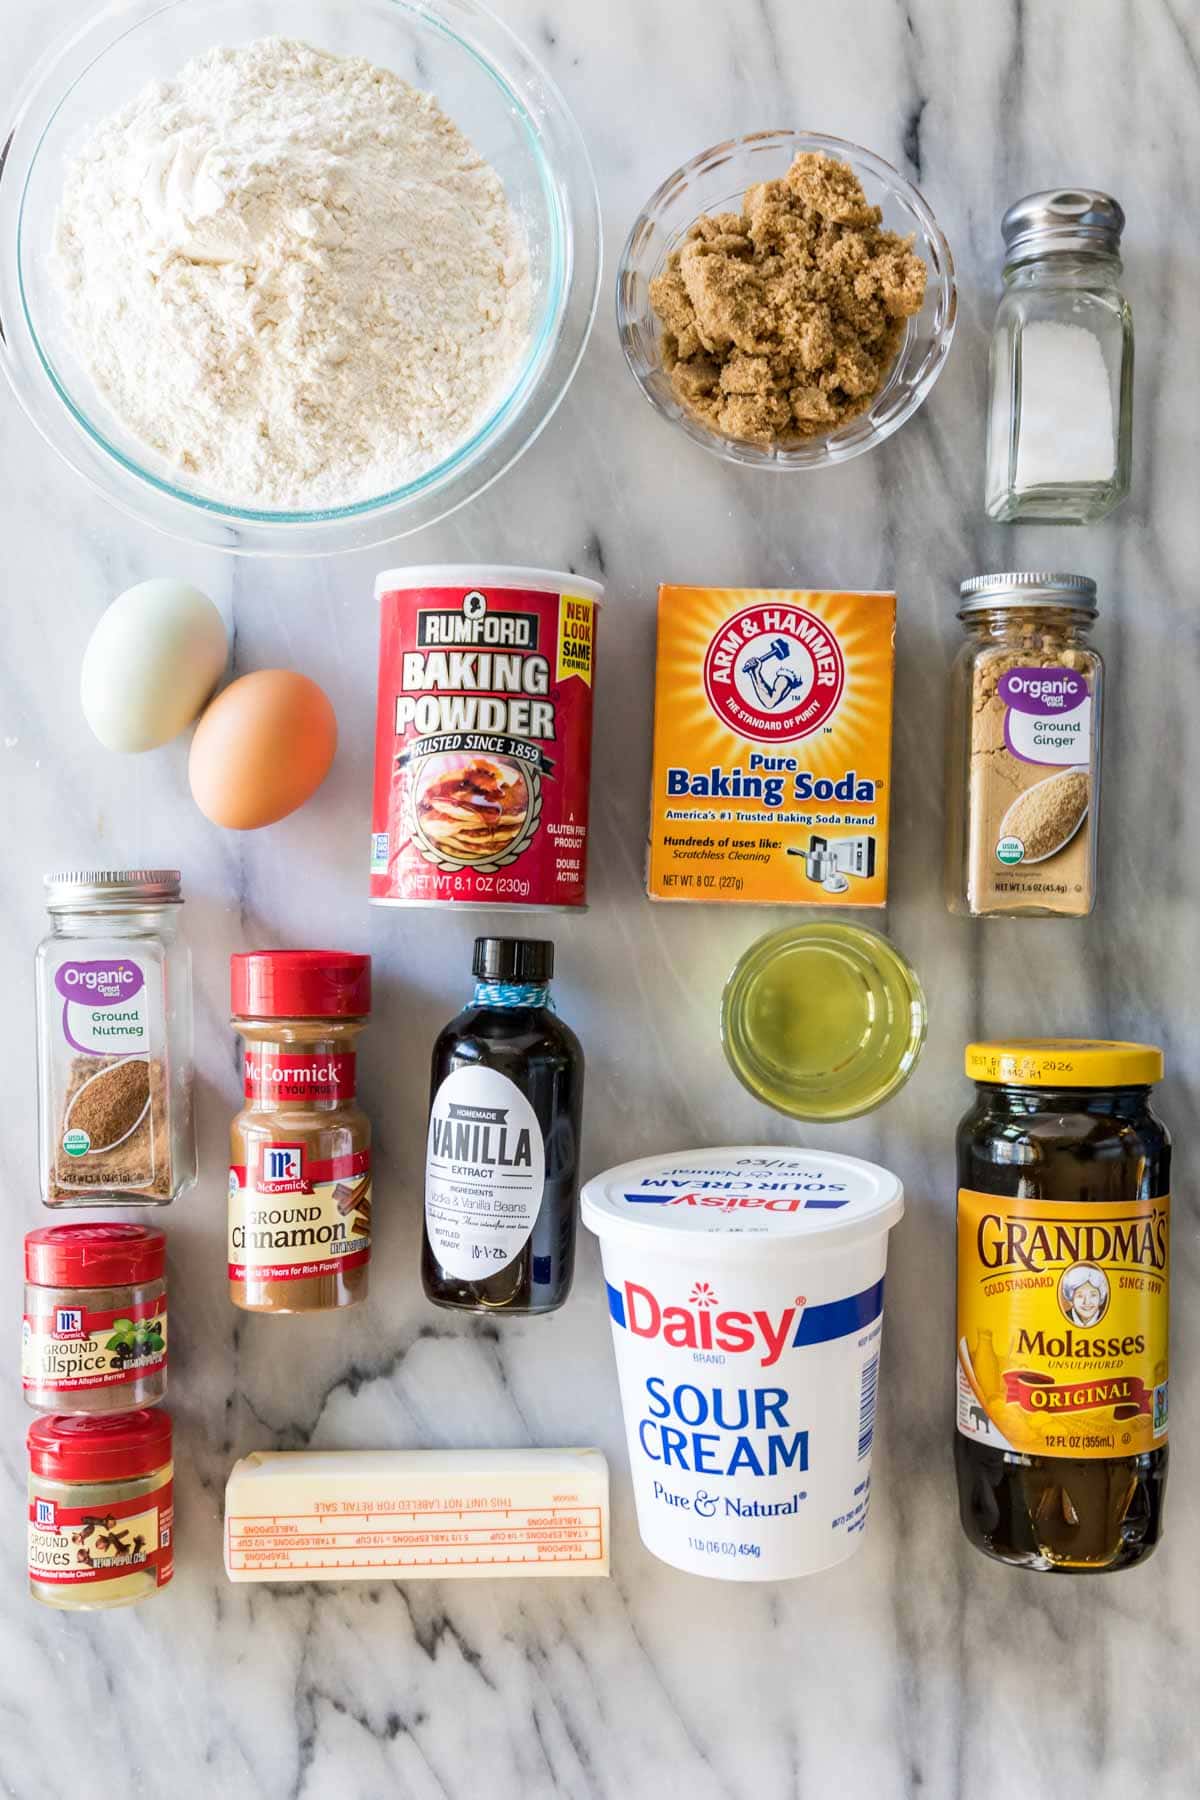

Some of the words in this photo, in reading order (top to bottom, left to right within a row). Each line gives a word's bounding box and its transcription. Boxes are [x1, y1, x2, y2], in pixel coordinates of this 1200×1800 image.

[567, 602, 590, 623] NEW
[425, 615, 529, 646] RUMFORD
[564, 621, 590, 643] LOOK
[563, 640, 590, 660] SAME
[713, 630, 745, 685] ARM
[741, 618, 762, 638] &
[762, 611, 836, 687] HAMMER
[403, 652, 549, 696] BAKING
[1008, 676, 1078, 698] Organic
[396, 695, 555, 739] POWDER
[726, 697, 738, 714] THE
[738, 710, 782, 730] STANDARD
[784, 718, 795, 729] OF
[794, 699, 821, 725] PURITY
[1033, 721, 1080, 732] Ground
[1033, 735, 1076, 748] Ginger
[411, 735, 460, 758] RUSTED
[464, 735, 504, 752] SINCE
[510, 742, 539, 762] 1859
[750, 754, 797, 771] Pure
[667, 768, 784, 806] Baking
[794, 772, 875, 802] Soda
[666, 810, 716, 820] America's
[720, 812, 732, 820] #1
[736, 812, 773, 822] Trusted
[776, 814, 812, 825] Baking
[816, 814, 841, 824] Soda
[844, 815, 876, 826] Brand
[547, 824, 574, 835] GLUTEN
[554, 838, 582, 848] PRODUCT
[663, 836, 714, 847] Hundreds
[718, 836, 730, 848] of
[732, 839, 756, 848] uses
[759, 838, 782, 848] like:
[672, 848, 724, 860] Scratchless
[728, 851, 771, 864] Cleaning
[556, 858, 580, 869] DOUBLE
[556, 872, 578, 882] ACTING
[663, 874, 678, 886] NET
[696, 876, 702, 888] 8
[719, 876, 744, 890] (227g)
[432, 876, 452, 890] WT
[454, 877, 472, 890] 8.1
[476, 878, 494, 892] OZ
[496, 878, 530, 896] (230g)
[995, 882, 1008, 892] NET
[1010, 882, 1020, 892] WT
[1034, 883, 1042, 892] OZ
[64, 968, 134, 989] Organic
[92, 1011, 138, 1022] Ground
[92, 1026, 144, 1036] Nutmeg
[244, 1061, 338, 1082] McCormick
[1042, 1061, 1074, 1072] 2026
[456, 1108, 497, 1120] HOMEMADE
[433, 1117, 532, 1168] VANILLA
[452, 1165, 494, 1178] EXTRACT
[671, 1168, 738, 1178] Natural
[777, 1171, 822, 1179] Pure
[256, 1181, 308, 1193] McCormick
[640, 1178, 751, 1190] CREAM
[758, 1182, 848, 1192] SOUR
[450, 1186, 494, 1198] INGREDIENTS
[462, 1198, 490, 1211] Vanilla
[494, 1200, 526, 1213] Beans
[670, 1192, 801, 1213] Daisy
[976, 1209, 1166, 1273] GRANDMA'S
[290, 1268, 302, 1276] for
[302, 1266, 318, 1274] Rich
[319, 1262, 340, 1272] Flavor
[984, 1284, 1004, 1298] GOLD
[1005, 1277, 1054, 1292] STANDARD
[1118, 1276, 1144, 1290] SINCE
[624, 1280, 796, 1368] Daisy
[1017, 1328, 1145, 1358] Molasses
[692, 1352, 726, 1365] BRAND
[1048, 1360, 1124, 1369] UNSULPHURED
[78, 1376, 102, 1386] Allspice
[104, 1373, 126, 1382] Berries
[1031, 1382, 1132, 1408] ORIGINAL
[645, 1376, 790, 1430] SOUR
[1046, 1434, 1056, 1446] 12
[1070, 1436, 1080, 1447] OZ
[638, 1419, 810, 1478] CREAM
[377, 1500, 396, 1511] FOR
[399, 1499, 440, 1510] LABELED
[444, 1498, 463, 1508] NOT
[470, 1498, 489, 1508] UNIT
[492, 1497, 512, 1508] THIS
[653, 1480, 690, 1510] Pure
[694, 1490, 720, 1518] &
[725, 1491, 798, 1518] Natural
[314, 1502, 338, 1512] SALE
[344, 1501, 374, 1512] RETAIL
[528, 1517, 582, 1526] TABLESPOONS
[244, 1526, 298, 1534] TABLESPOONS
[526, 1531, 582, 1540] TABLESPOONS
[238, 1540, 253, 1548] CUP
[274, 1538, 331, 1546] TABLESPOONS
[392, 1535, 450, 1544] TABLESPOONS
[538, 1544, 582, 1552] TEASPOONS
[706, 1539, 720, 1554] (16
[720, 1542, 737, 1557] OZ)
[738, 1544, 760, 1558] 454g
[245, 1552, 288, 1561] TEASPOONS
